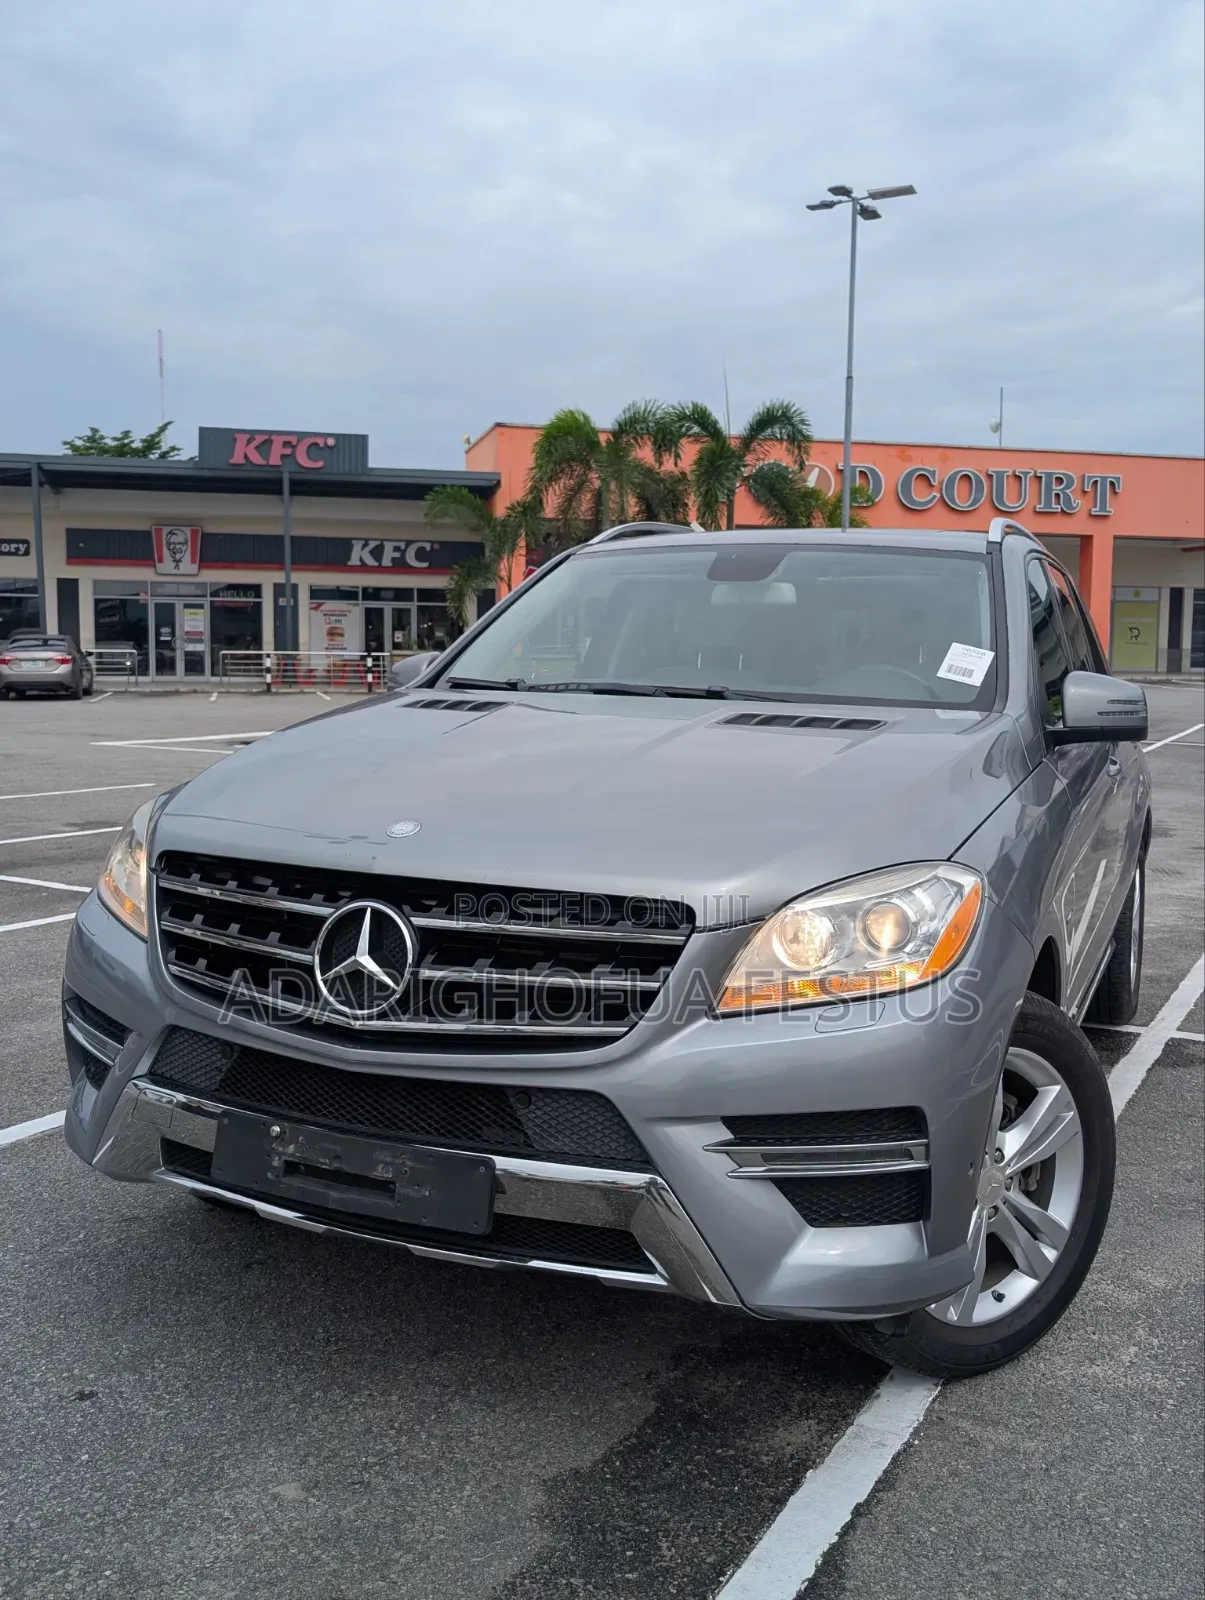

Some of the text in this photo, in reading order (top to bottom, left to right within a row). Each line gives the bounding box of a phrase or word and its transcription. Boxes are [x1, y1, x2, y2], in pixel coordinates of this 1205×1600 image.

[229, 433, 325, 468] KFC
[898, 466, 1123, 516] COURT
[0, 543, 28, 555] ory
[347, 540, 432, 567] KFC
